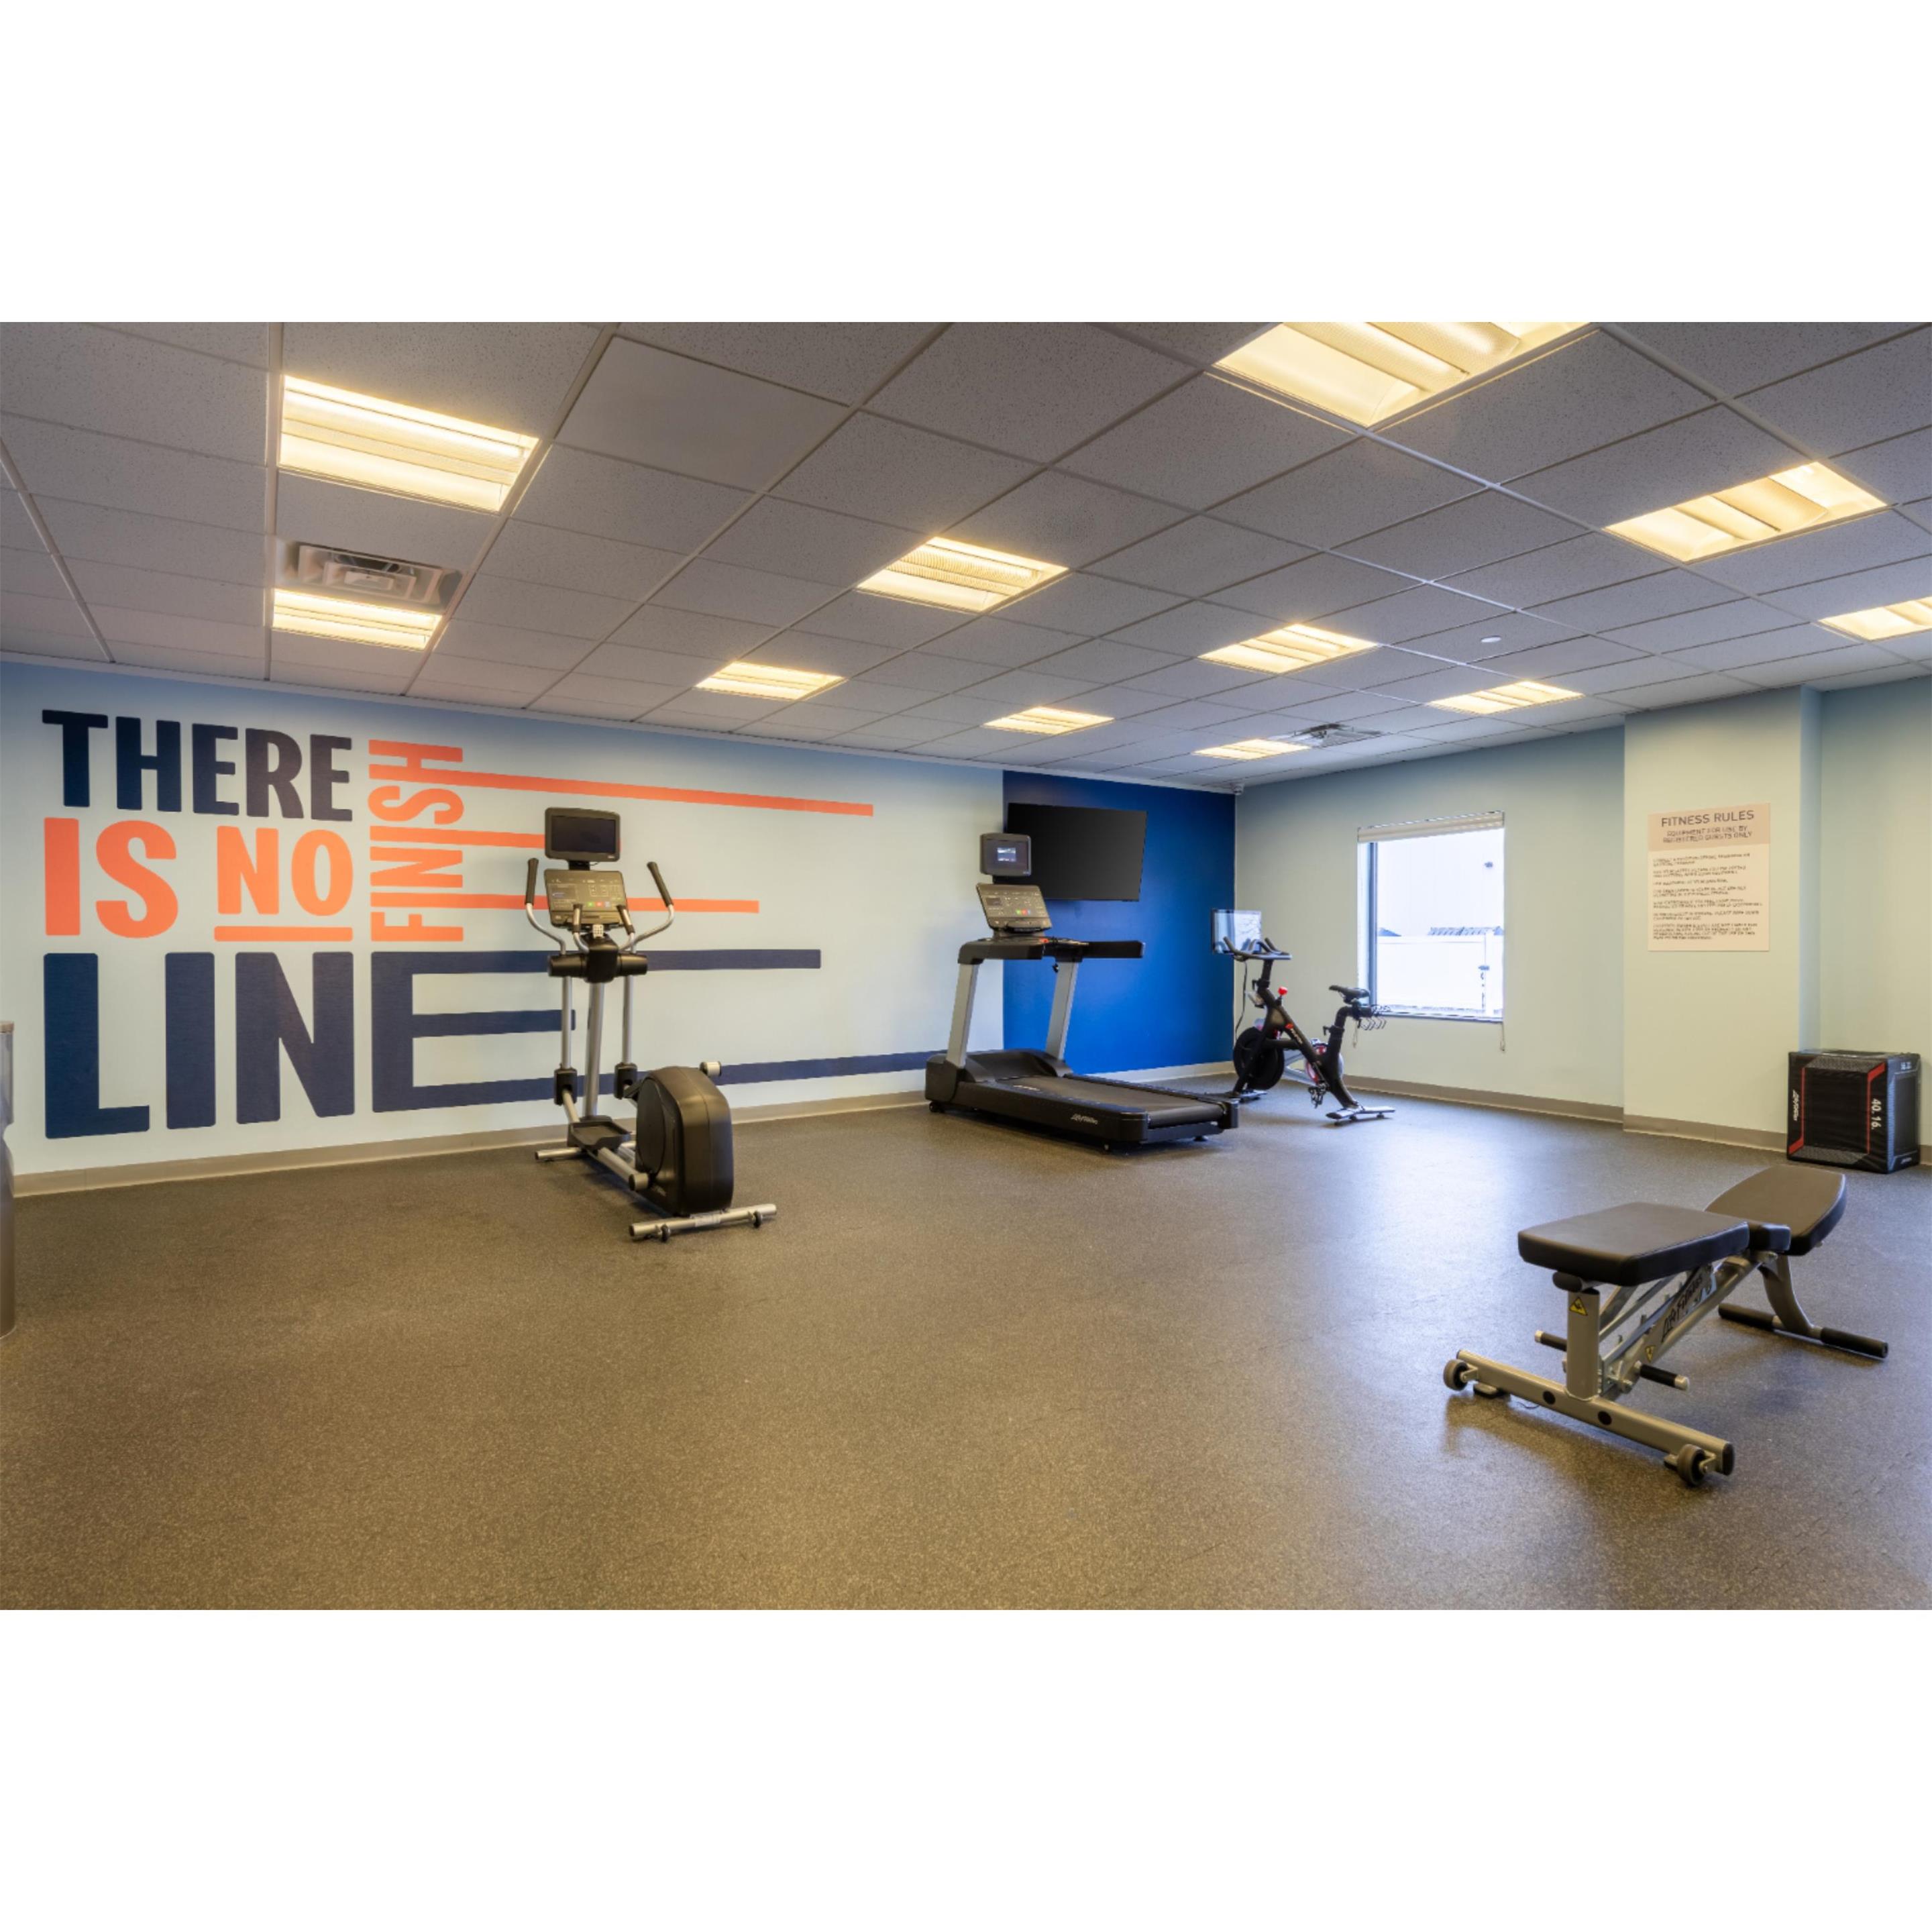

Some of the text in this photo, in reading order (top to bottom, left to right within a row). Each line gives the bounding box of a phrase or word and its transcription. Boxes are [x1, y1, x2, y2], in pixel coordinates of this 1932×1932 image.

[42, 709, 353, 822] THERE
[1661, 810, 1754, 827] FITNESS RULES
[44, 817, 354, 938] IS NO
[368, 739, 464, 942] FINISH
